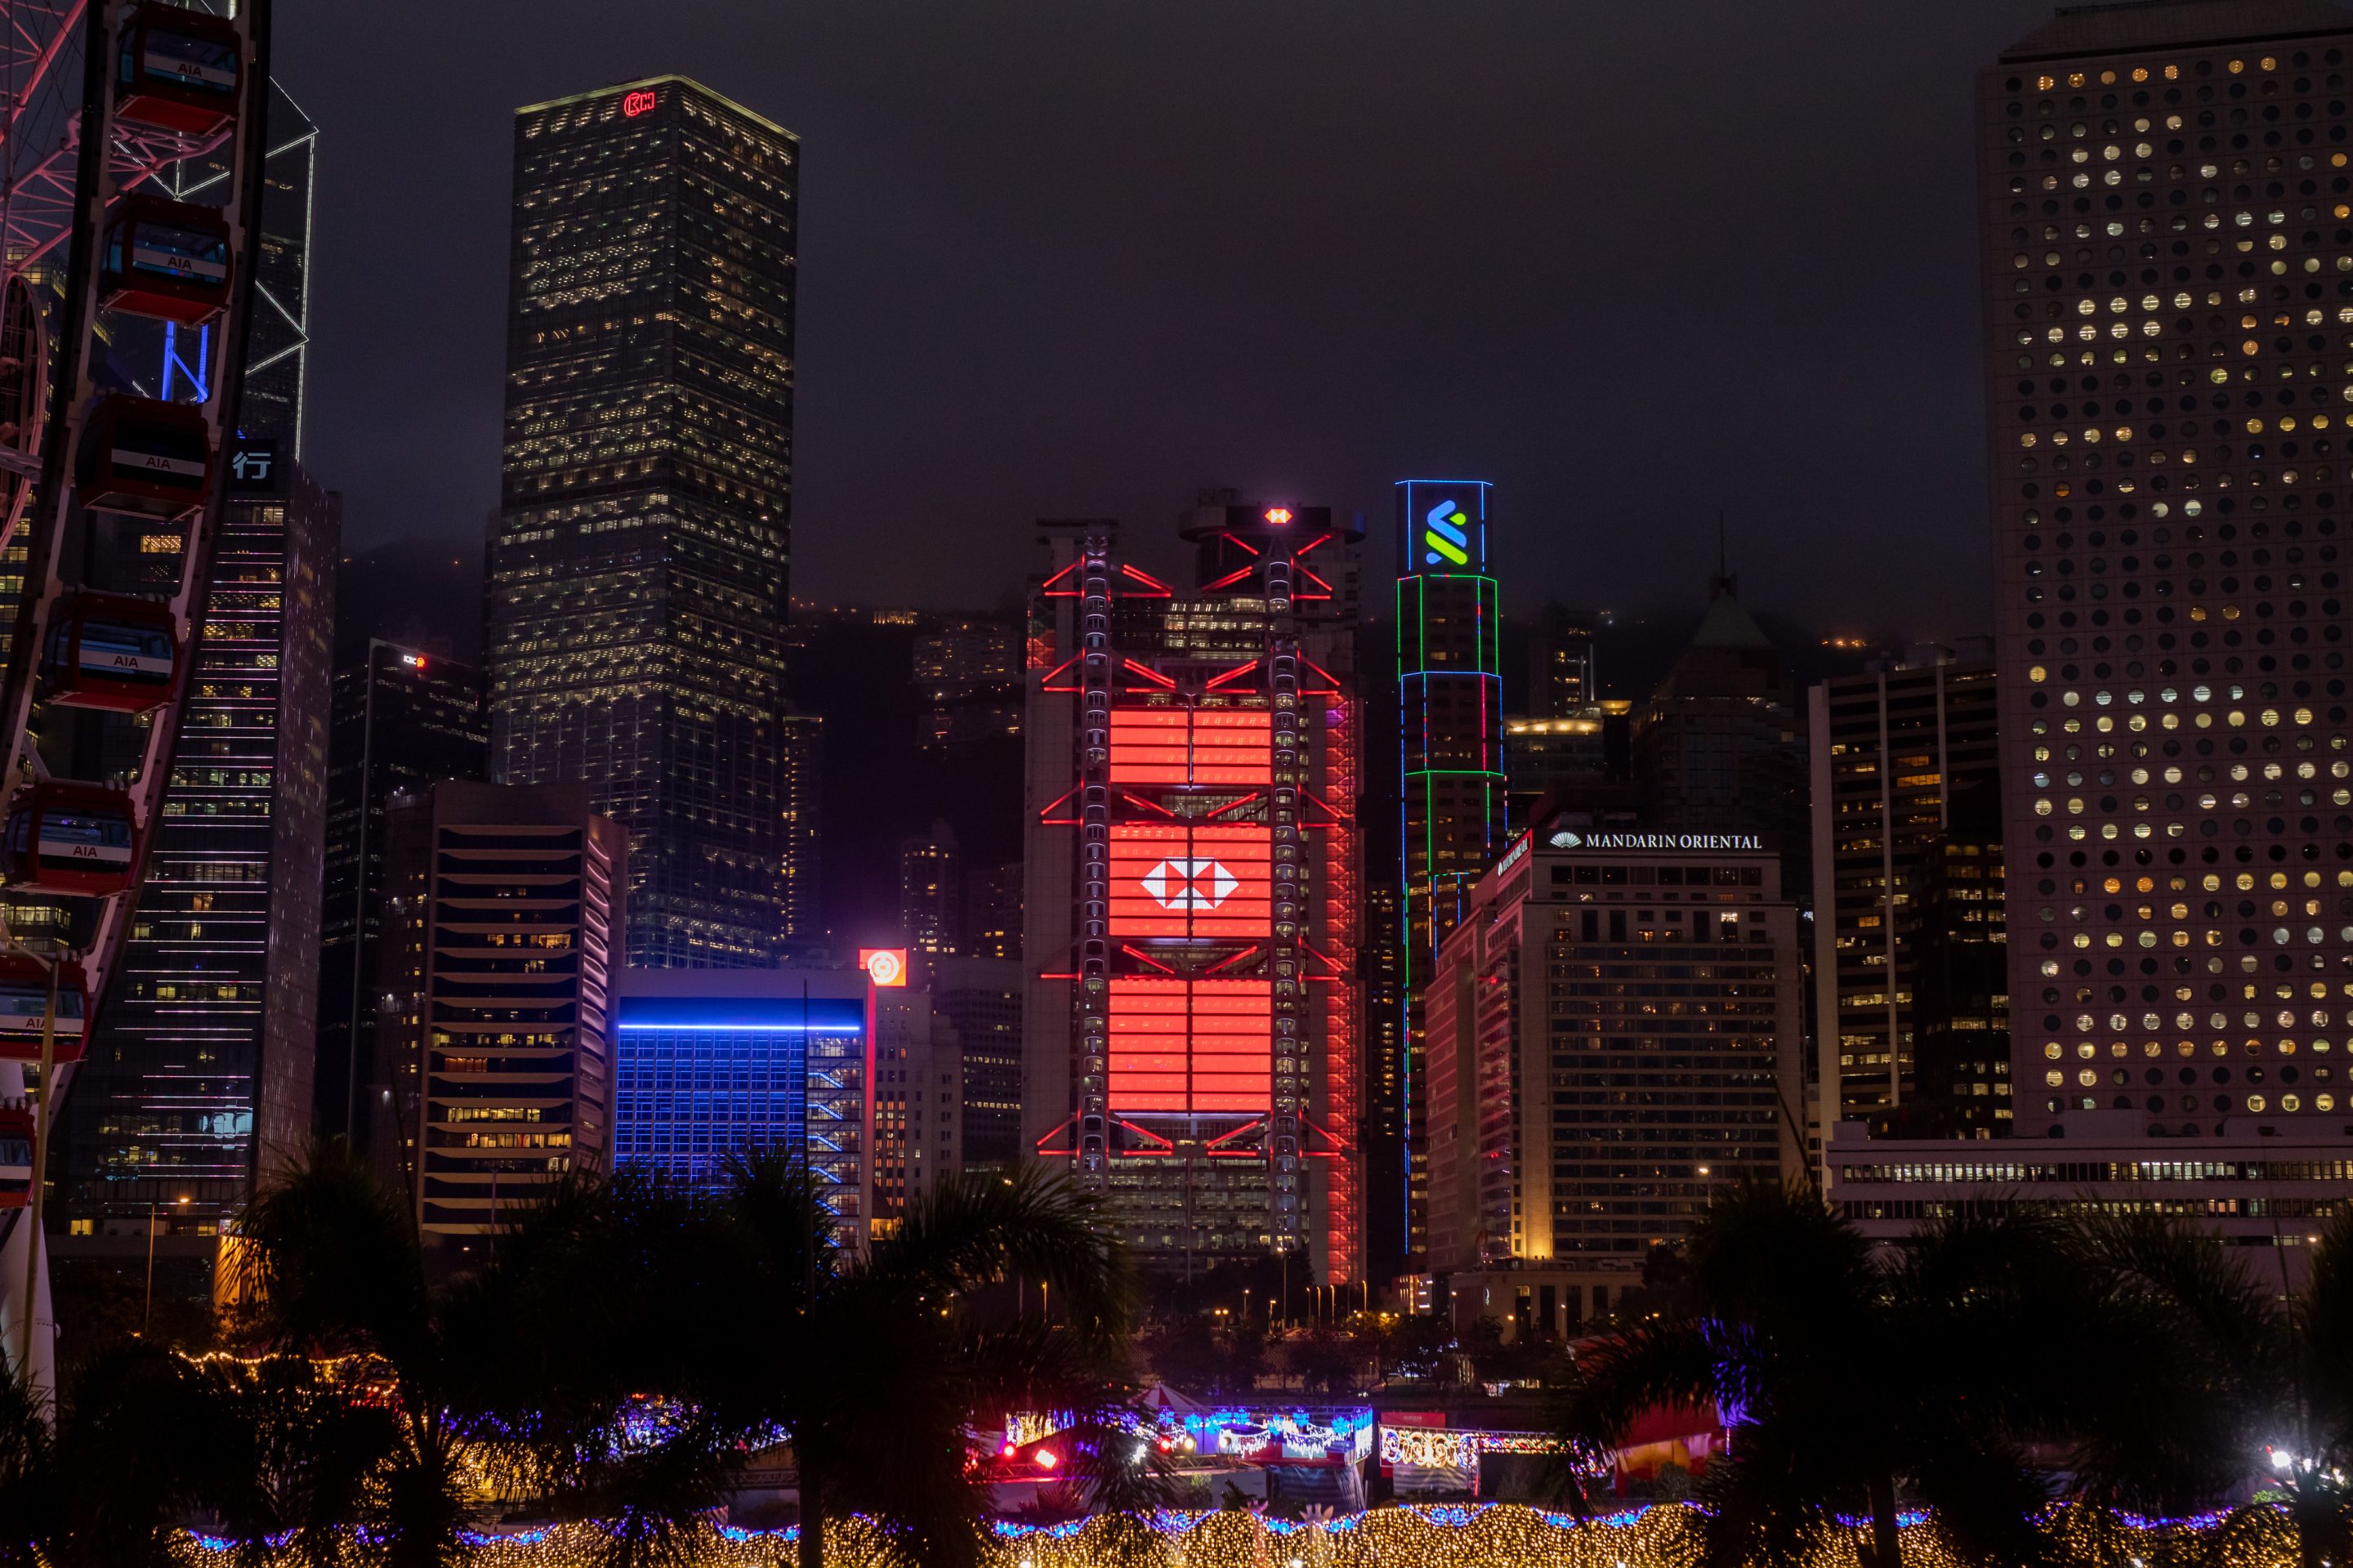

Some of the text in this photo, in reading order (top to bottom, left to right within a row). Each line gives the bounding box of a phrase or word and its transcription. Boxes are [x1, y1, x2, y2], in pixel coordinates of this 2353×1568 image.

[178, 63, 202, 78] AIA
[167, 256, 192, 270] AIA
[145, 456, 171, 471] AIA
[232, 450, 272, 480] 行
[114, 654, 139, 668] AIA
[1586, 834, 1763, 849] MANDARIN ORIENTAL
[73, 845, 97, 858] AIA
